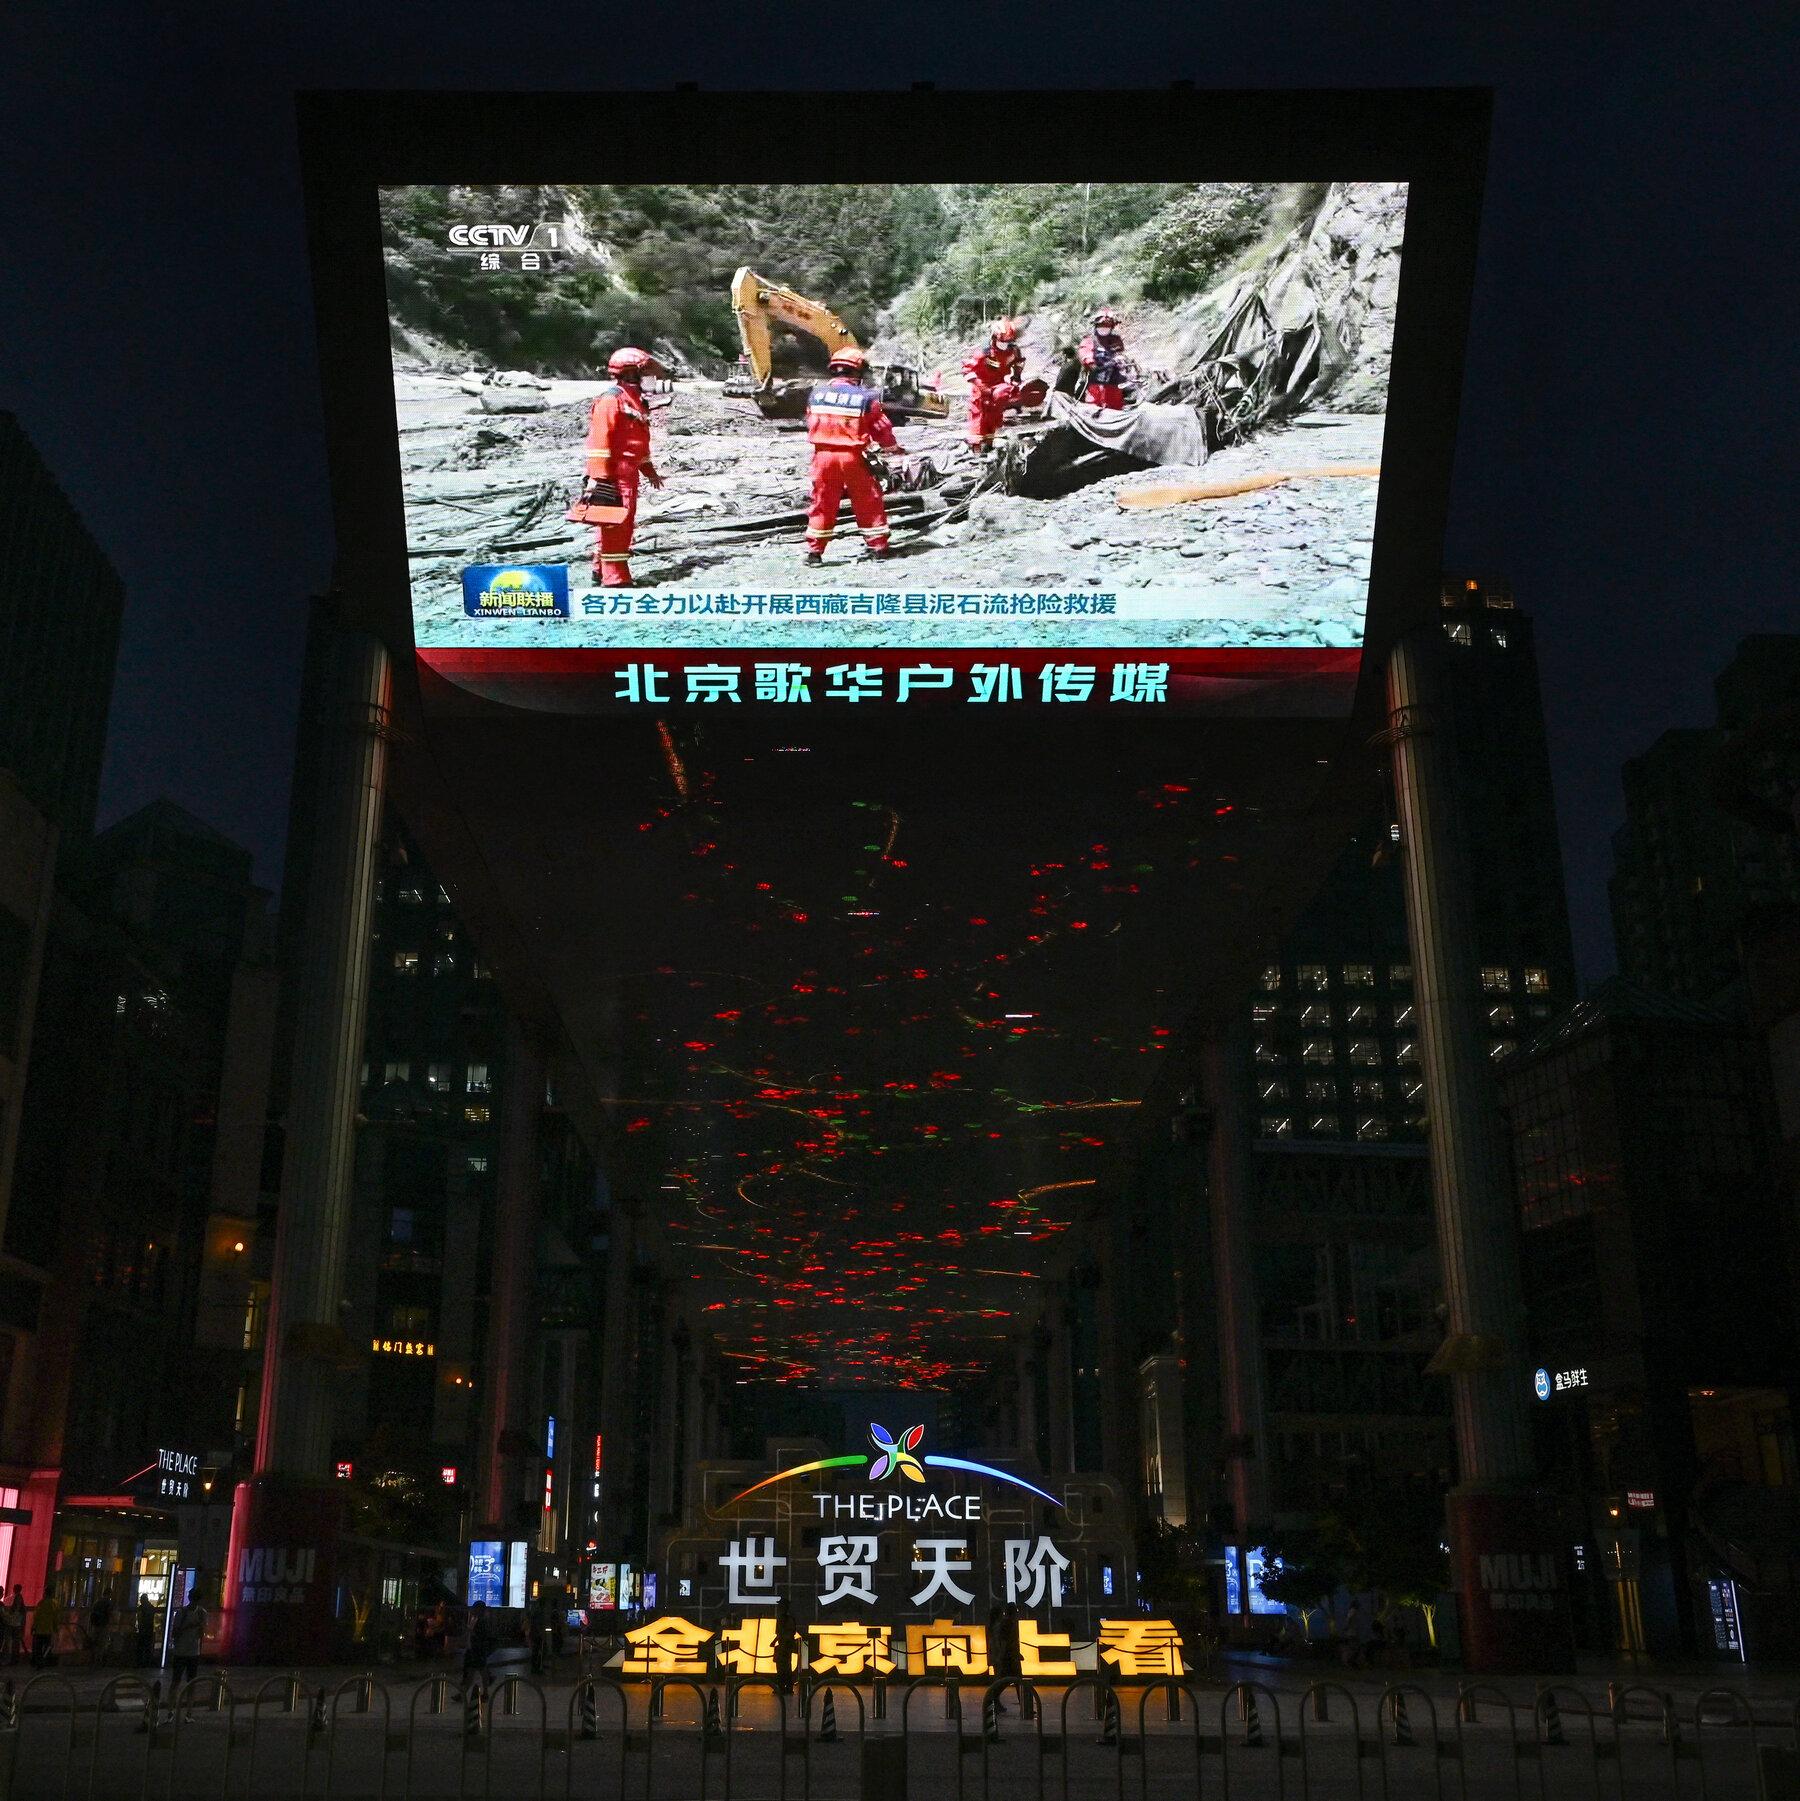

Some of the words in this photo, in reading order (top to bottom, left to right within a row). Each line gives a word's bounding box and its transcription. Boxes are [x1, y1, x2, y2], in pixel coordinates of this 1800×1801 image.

[448, 225, 530, 246] CCTV
[480, 252, 541, 270] 综合
[474, 608, 517, 616] XINWEN
[479, 592, 554, 608] 新闻联播
[581, 593, 1117, 615] 各方全力以赴开展西藏吉隆县泥石流抢险救援
[614, 662, 1170, 703] 北京歌华户外传媒
[1555, 1368, 1589, 1390] 盒马鲜生
[159, 1449, 174, 1470] THE
[175, 1452, 198, 1475] PLACE
[813, 1494, 874, 1520] THE
[888, 1494, 981, 1520] PLACE
[239, 1548, 315, 1584] MUJI
[718, 1535, 1071, 1608] 世贸天阶
[622, 1616, 1186, 1676] 全北京向上看
